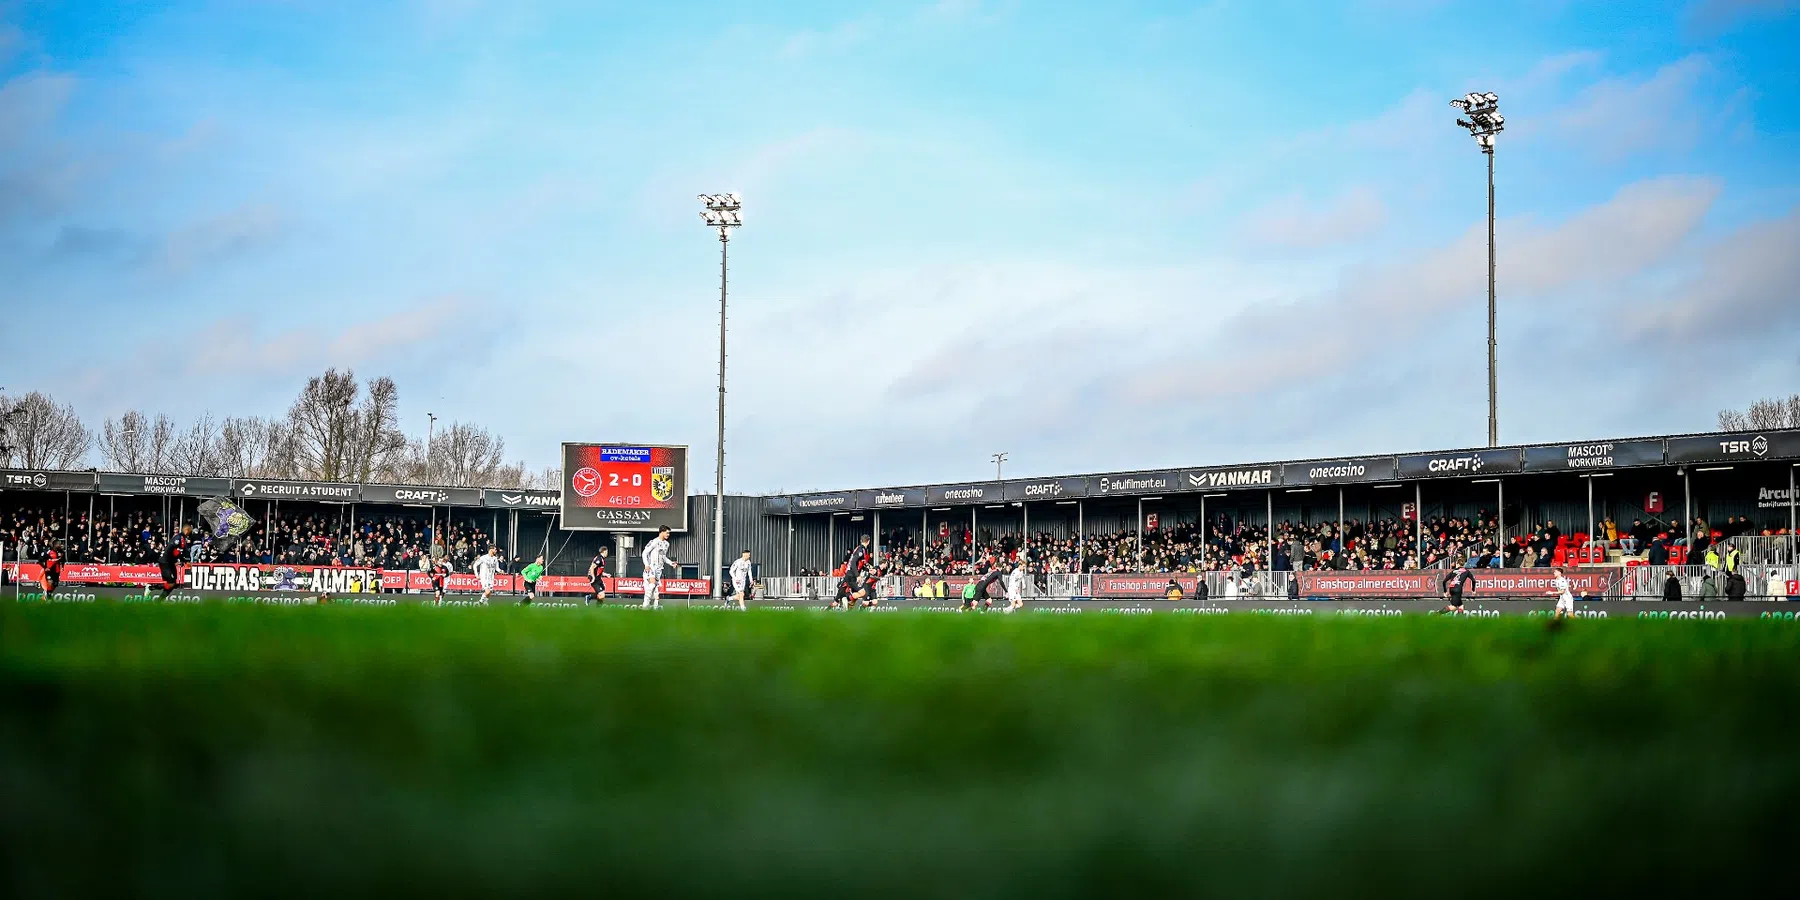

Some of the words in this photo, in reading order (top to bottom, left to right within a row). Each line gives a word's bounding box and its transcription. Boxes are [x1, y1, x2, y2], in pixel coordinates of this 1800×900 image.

[601, 448, 649, 456] RADEMAKER
[1720, 442, 1750, 453] TSR
[1429, 457, 1472, 472] CRAFT
[1567, 456, 1613, 467] WORKWEAR
[1309, 461, 1365, 479] onecasino
[6, 474, 32, 484] TSR
[1208, 469, 1271, 486] YANMAR
[143, 485, 186, 494] WORKWEAR
[1025, 484, 1054, 496] CRAFT
[1111, 478, 1166, 490] efulfilment.eu
[260, 485, 301, 496] RECRUIT
[302, 487, 310, 496] A
[311, 487, 353, 497] STUDENT
[395, 489, 437, 501] CRAFT
[944, 486, 983, 500] onecasino
[1758, 486, 1800, 500] Arcui
[524, 494, 561, 506] YANM
[609, 496, 641, 505] 46:09
[1648, 491, 1659, 509] F
[596, 509, 652, 521] GASSAN
[382, 576, 402, 584] OEP
[1316, 577, 1421, 592] Fanshop.almerecity.nl
[228, 593, 301, 605] onecasino
[1034, 603, 1082, 614] onecasino
[1100, 603, 1153, 615] onecasino
[1172, 603, 1229, 616] onecasino
[1251, 603, 1312, 616] onecasino
[1336, 604, 1402, 616] onecasino
[1638, 605, 1726, 620] onecasino
